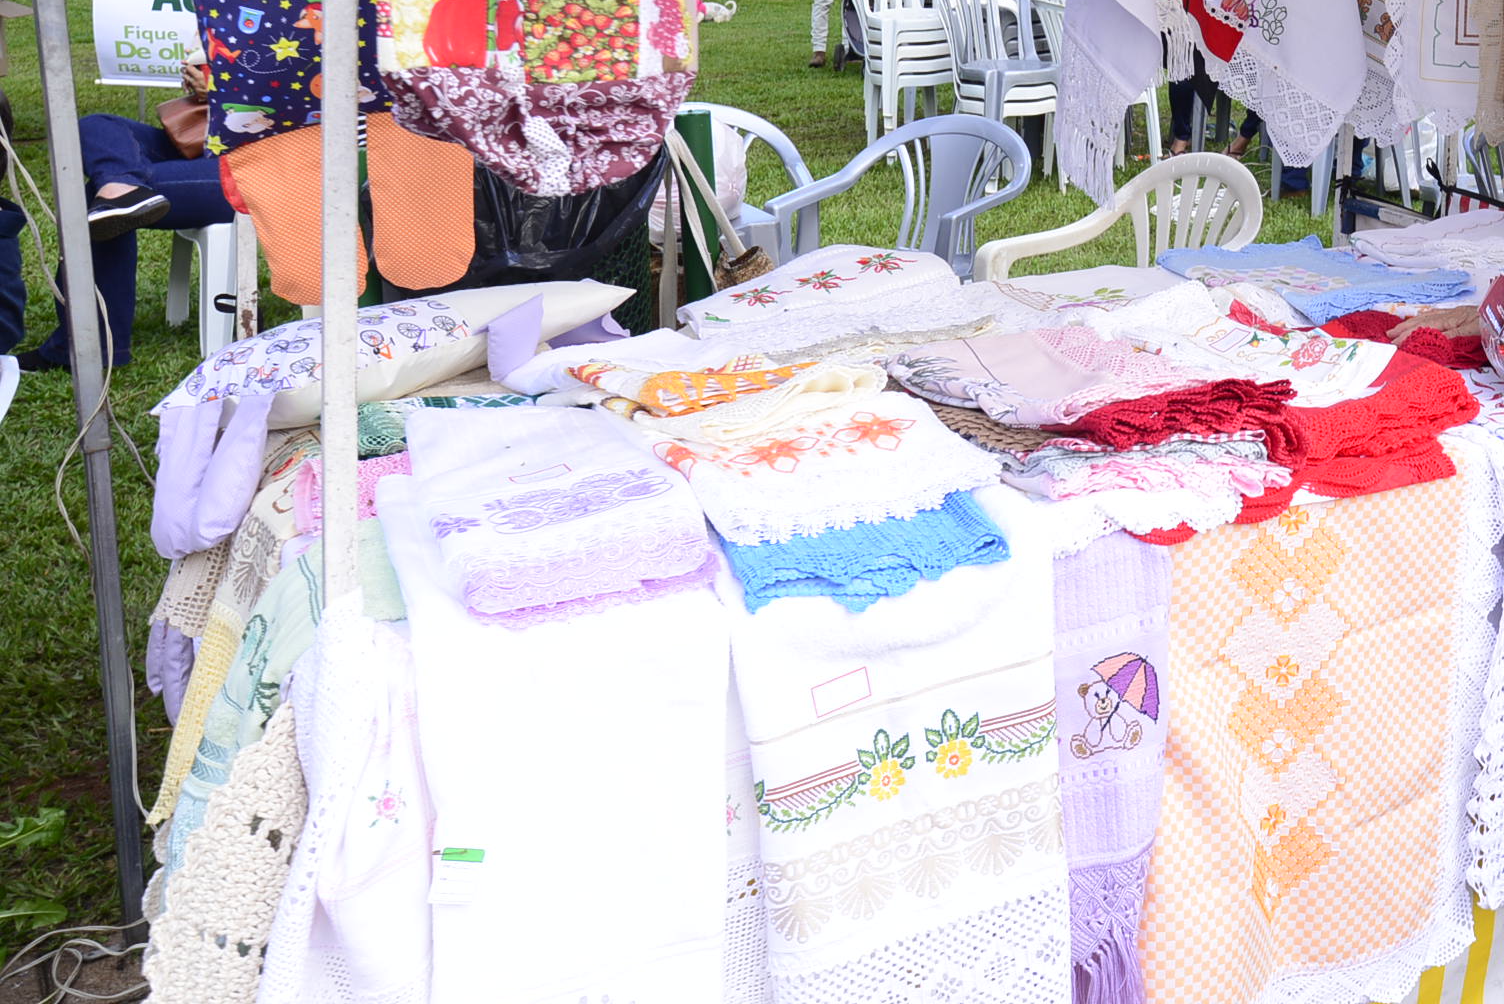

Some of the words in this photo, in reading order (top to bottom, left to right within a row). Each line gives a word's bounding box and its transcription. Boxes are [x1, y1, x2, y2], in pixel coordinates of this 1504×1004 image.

[124, 25, 178, 43] Fique
[114, 40, 152, 59] De
[118, 63, 141, 73] na
[147, 61, 181, 74] saú
